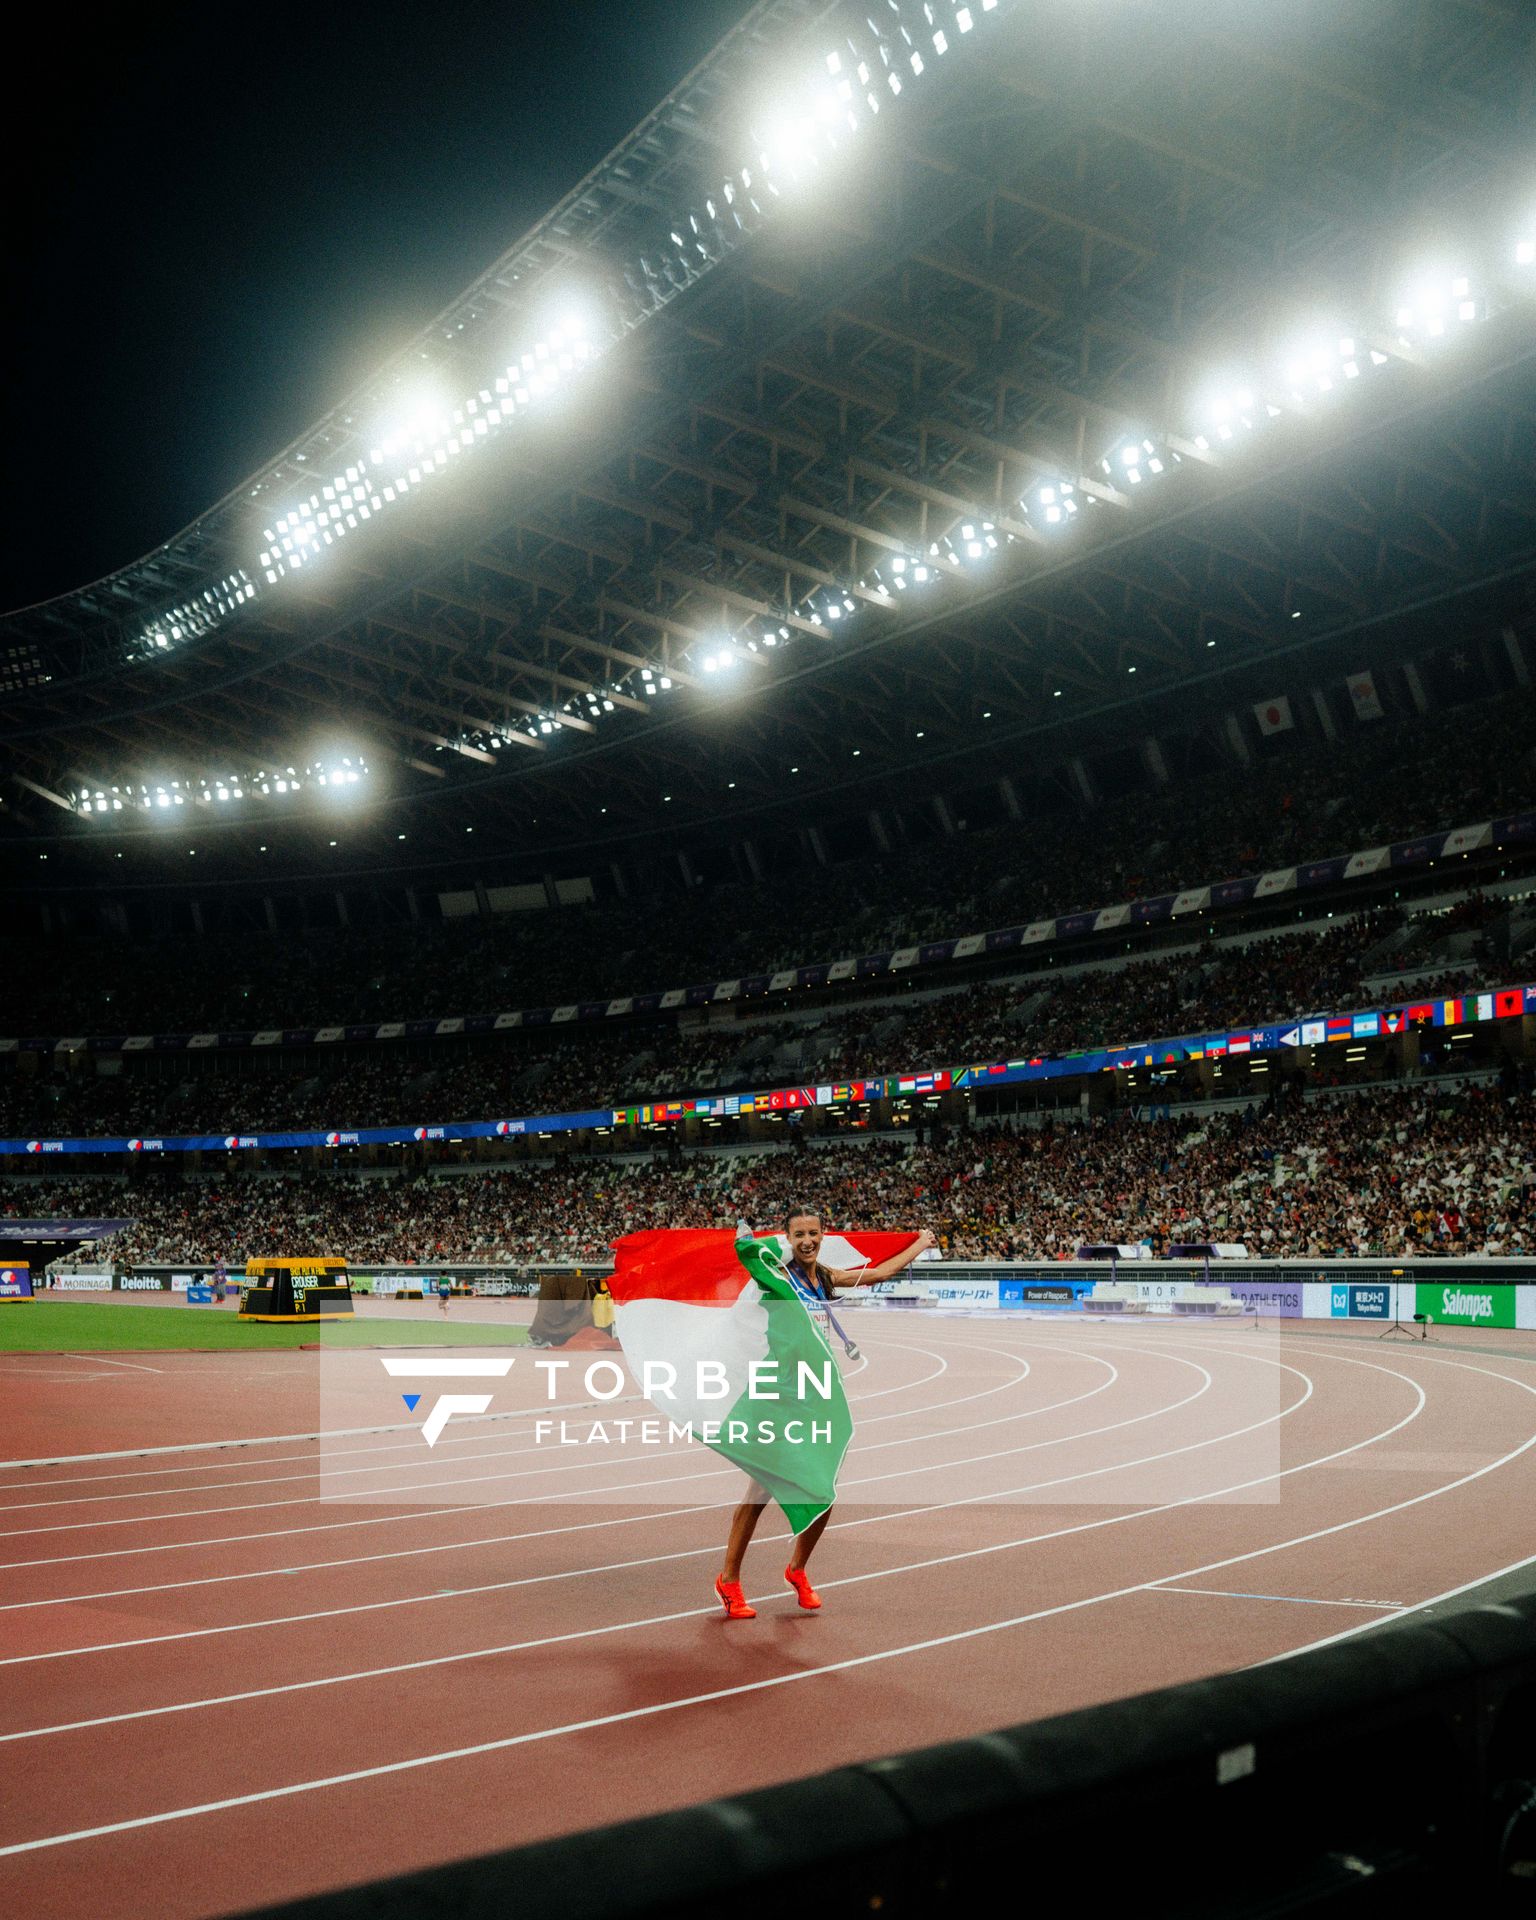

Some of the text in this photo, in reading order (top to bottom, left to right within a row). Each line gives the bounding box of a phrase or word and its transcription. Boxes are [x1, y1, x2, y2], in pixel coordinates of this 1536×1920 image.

[63, 1279, 111, 1289] MORINAGA
[1142, 1286, 1177, 1297] MOR
[1249, 1293, 1299, 1308] ATHLETICS
[1442, 1288, 1493, 1321] Salonpas
